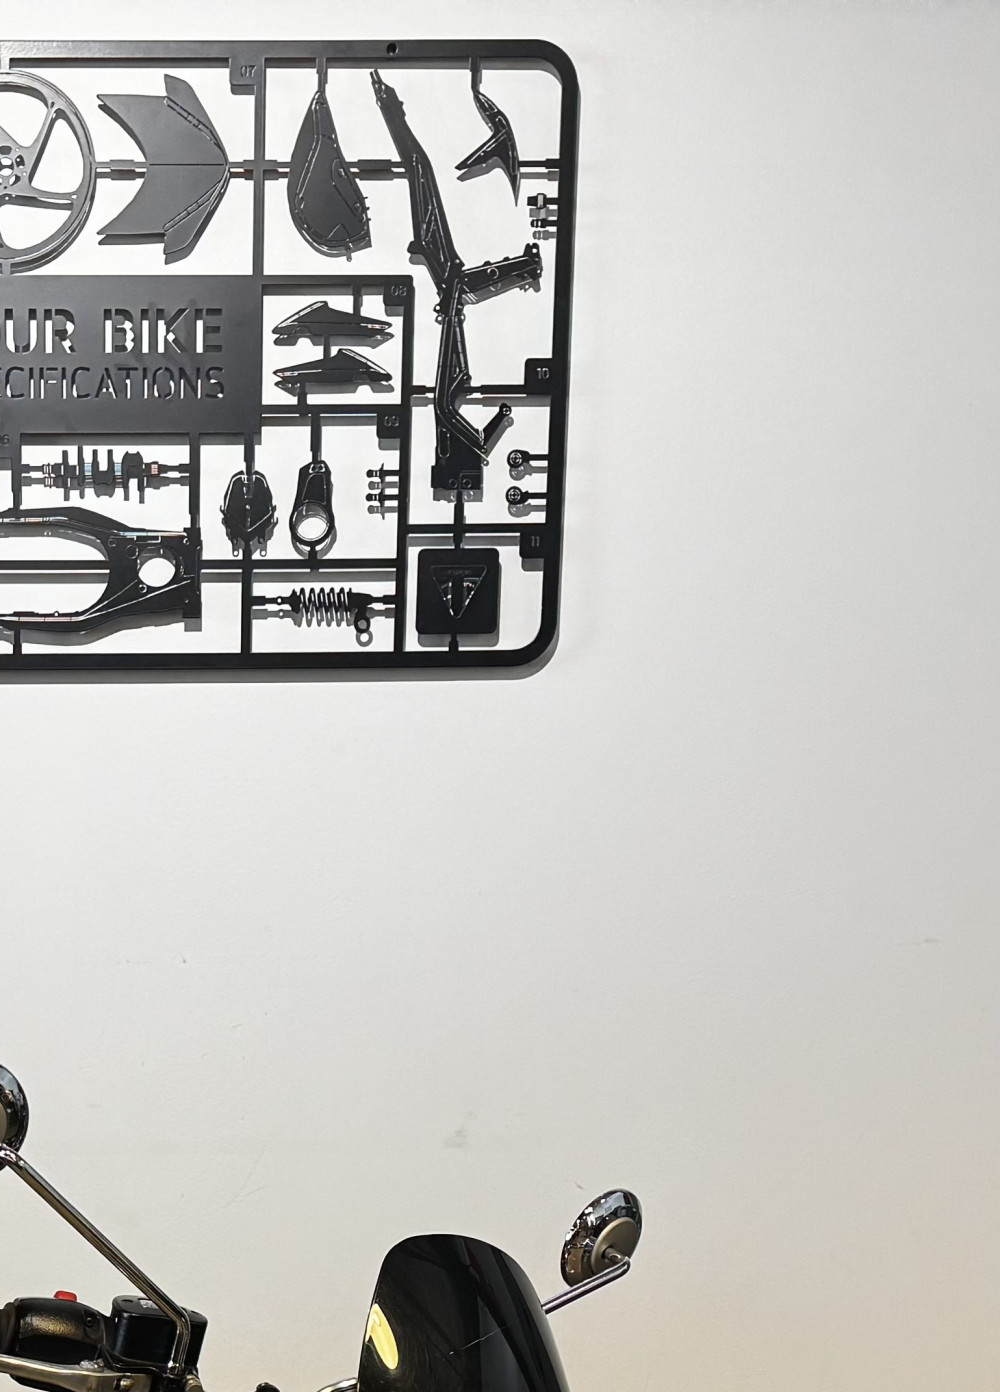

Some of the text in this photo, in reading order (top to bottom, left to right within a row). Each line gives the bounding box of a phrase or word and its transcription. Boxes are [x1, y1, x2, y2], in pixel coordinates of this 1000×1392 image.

[240, 64, 257, 78] 07
[104, 307, 223, 354] BIKE
[536, 367, 550, 380] 10
[530, 535, 540, 547] 11
